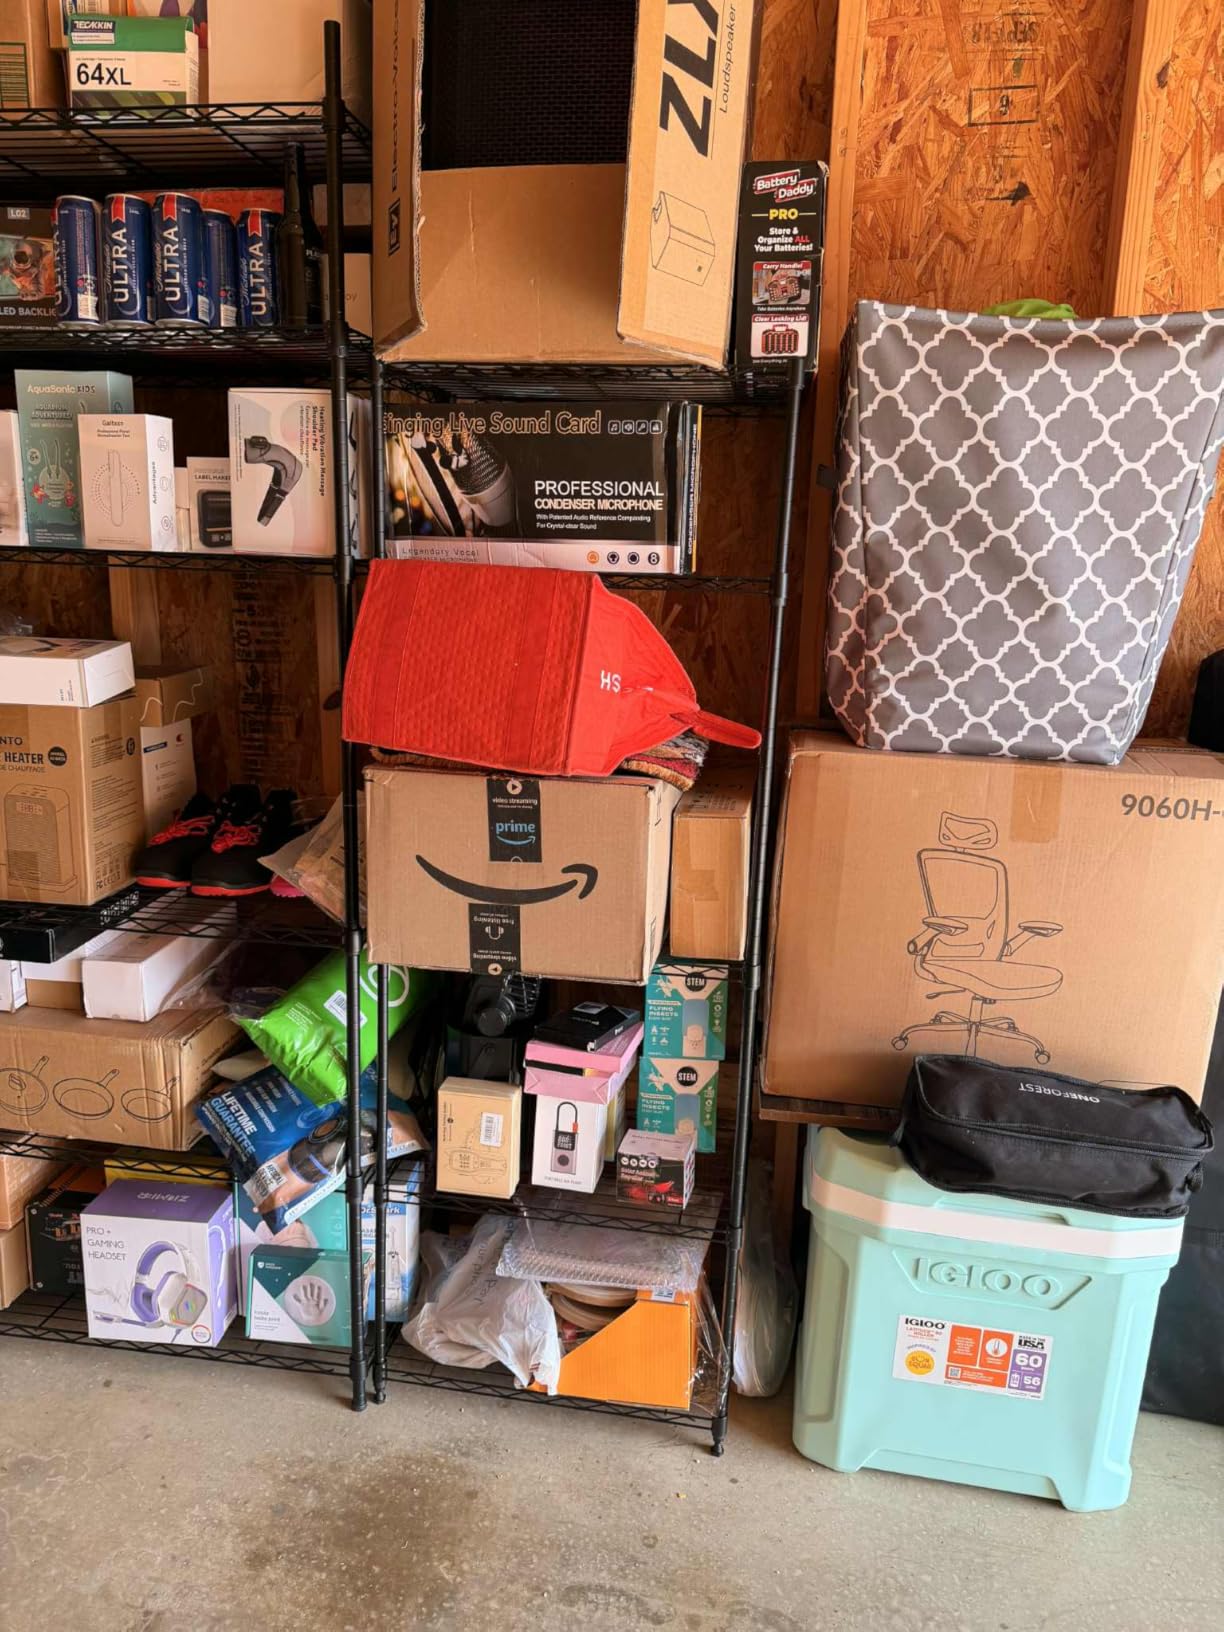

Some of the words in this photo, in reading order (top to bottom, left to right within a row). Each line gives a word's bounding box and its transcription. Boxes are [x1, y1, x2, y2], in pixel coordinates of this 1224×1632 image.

[719, 3, 736, 113] Loudspeaker
[76, 63, 132, 85] 64XL
[756, 174, 798, 191] Battery
[778, 184, 814, 199] Daddy
[769, 208, 799, 220] PRO
[769, 227, 791, 236] Store
[757, 235, 793, 245] Organize
[794, 235, 810, 243] ALL
[754, 244, 772, 253] Your
[774, 243, 813, 252] Batteries!
[112, 227, 130, 303] ULTRA
[163, 225, 181, 301] ULTRA
[763, 263, 778, 271] Carry
[249, 241, 267, 316] ULTRA
[0, 306, 16, 315] LED
[27, 384, 76, 394] AquaSonic
[77, 384, 96, 394] KIDS
[318, 405, 327, 433] Heating
[449, 411, 487, 434] Live
[489, 410, 550, 435] Sound
[555, 409, 602, 435] Card
[318, 434, 326, 466] Vibration
[194, 473, 211, 481] LABEL
[319, 467, 327, 497] Massage
[534, 480, 664, 496] PROFESSIONAL
[534, 498, 595, 511] CONDENSER
[597, 498, 663, 511] MICROPHONE
[600, 669, 621, 693] HS
[4, 751, 44, 765] HEATER
[1121, 793, 1224, 821] 9060H-
[495, 819, 536, 835] prime
[686, 977, 705, 986] STEM
[678, 1072, 697, 1081] STEM
[1018, 1082, 1100, 1103] ONEFOREST
[220, 1090, 258, 1135] LIFETIME
[211, 1097, 257, 1155] GUARANTEE
[86, 1226, 104, 1235] PRO
[87, 1238, 124, 1249] GAMING
[88, 1251, 127, 1261] HEADSET
[912, 1257, 1061, 1298] IGLOO
[905, 1317, 945, 1330] IGLOO
[1018, 1338, 1045, 1350] USA
[1015, 1352, 1043, 1368] 60
[1023, 1375, 1040, 1386] 56
